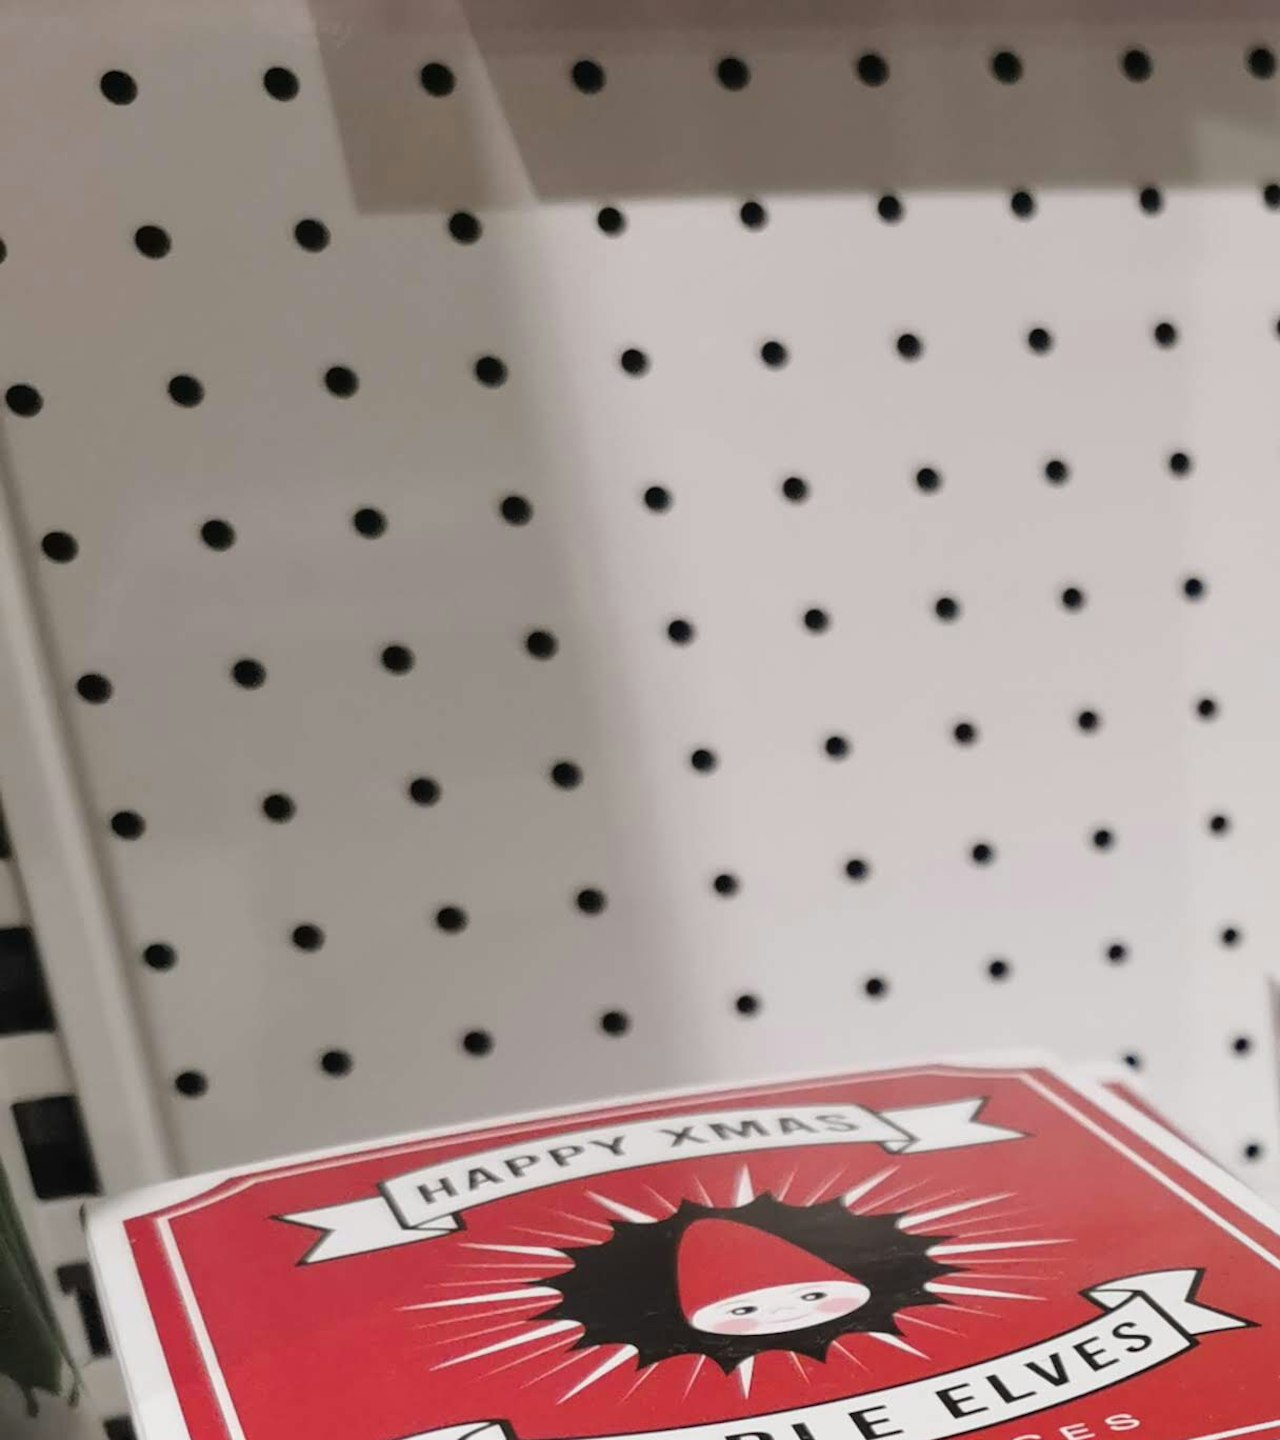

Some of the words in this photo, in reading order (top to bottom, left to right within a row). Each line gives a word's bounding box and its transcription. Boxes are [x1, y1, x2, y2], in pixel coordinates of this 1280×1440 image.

[416, 1136, 630, 1206] HAPPY
[659, 1112, 865, 1149] XMAS
[934, 1319, 1155, 1421] ELVES
